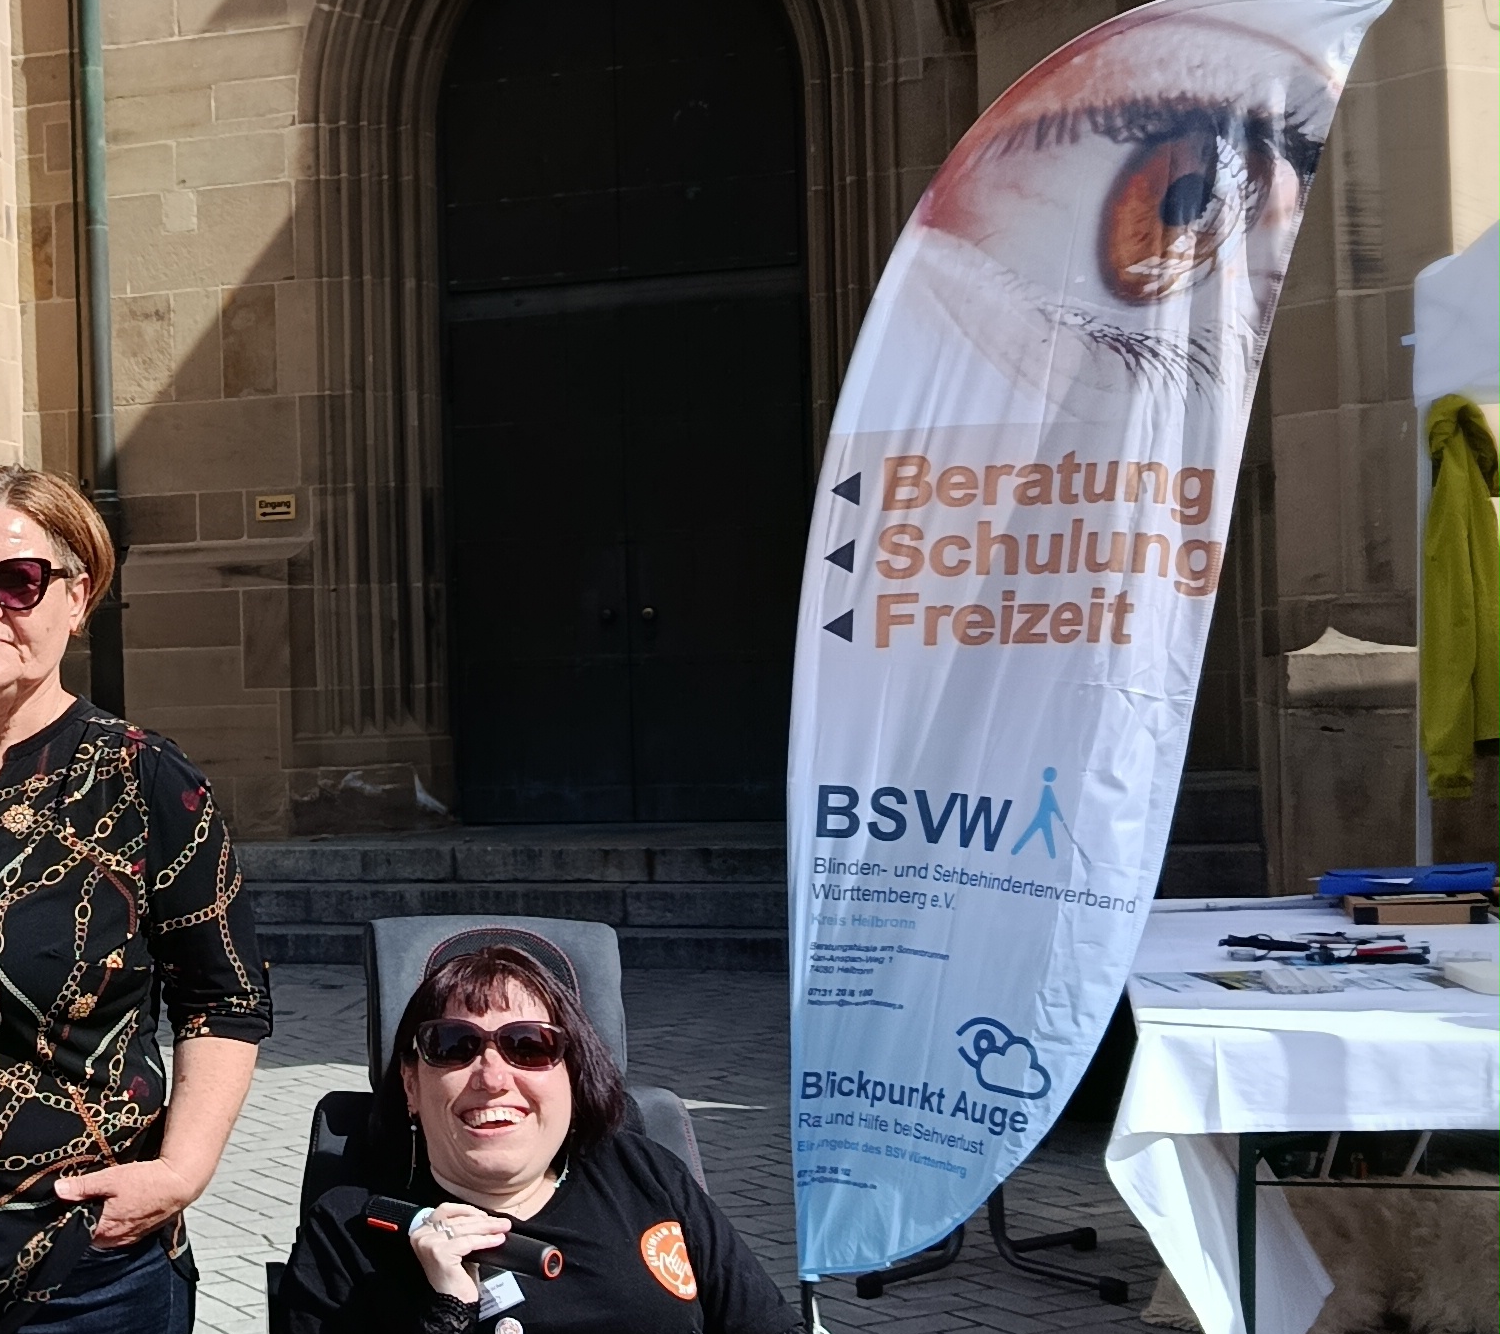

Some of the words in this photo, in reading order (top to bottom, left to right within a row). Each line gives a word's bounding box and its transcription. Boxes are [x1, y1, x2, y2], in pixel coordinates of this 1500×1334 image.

[259, 500, 291, 510] Eingang
[882, 451, 1215, 525] Beratung
[876, 519, 1223, 596] Schulung
[876, 588, 1134, 648] Freizeit
[815, 784, 1013, 852] BSVW
[812, 883, 927, 910] Württemberg
[930, 892, 956, 910] e.V.
[813, 857, 888, 877] Blinden-
[894, 861, 928, 880] und
[933, 864, 1136, 914] Sehbehindertenverband
[811, 913, 847, 926] Kreis
[851, 914, 916, 929] Heilbronn
[801, 1070, 945, 1114] Blickpunkt
[951, 1091, 1029, 1135] Auge
[825, 1111, 854, 1126] und
[858, 1112, 889, 1132] Hilfe
[912, 1123, 984, 1155] Sehverlust
[861, 1142, 881, 1155] des
